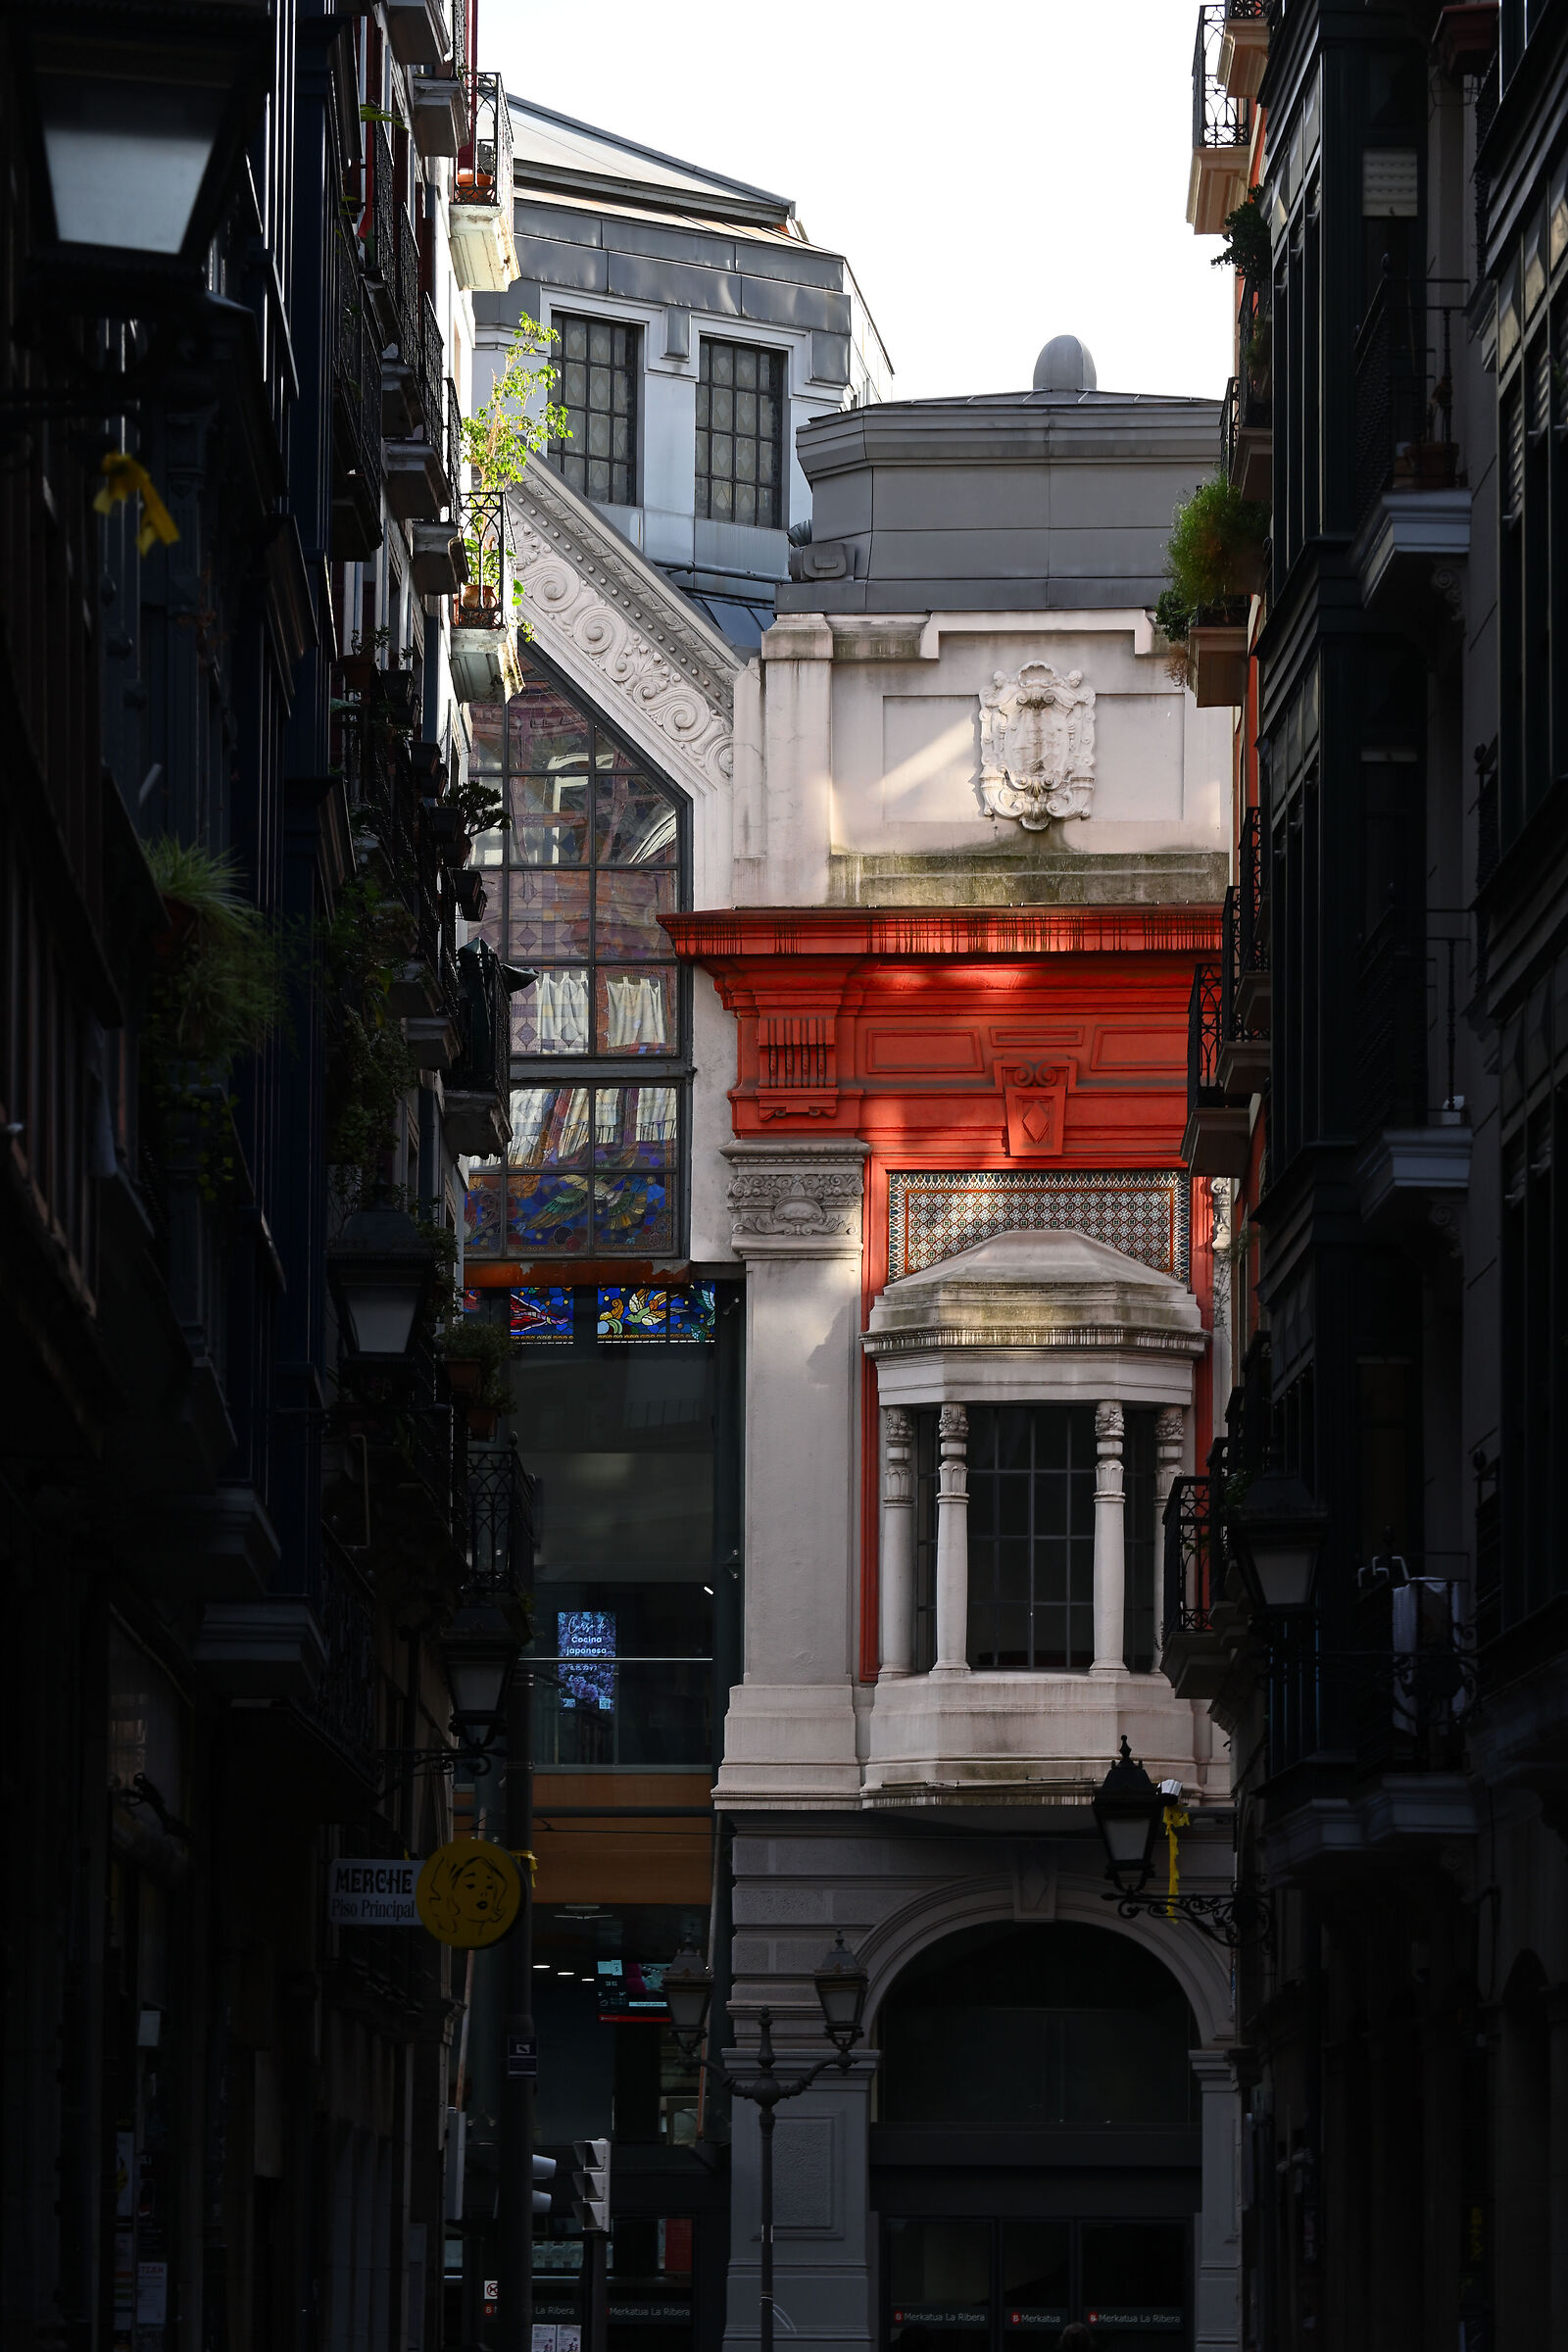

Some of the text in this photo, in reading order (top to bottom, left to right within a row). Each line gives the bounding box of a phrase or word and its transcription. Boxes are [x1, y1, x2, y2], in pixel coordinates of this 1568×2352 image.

[565, 1646, 607, 1655] japonesa
[335, 1868, 413, 1893] MERCHE
[331, 1898, 416, 1921] Piso Principal
[535, 2306, 546, 2315] La
[548, 2306, 575, 2315] Ribera
[610, 2307, 691, 2316] Merkatua La Ribera
[904, 2313, 944, 2322] Merkatua
[946, 2313, 956, 2322] La
[957, 2313, 986, 2322] Ribera
[1021, 2314, 1060, 2323] Merkatua
[1099, 2314, 1138, 2323] Merkatua
[1140, 2314, 1151, 2323] La
[1152, 2314, 1182, 2323] Ribera
